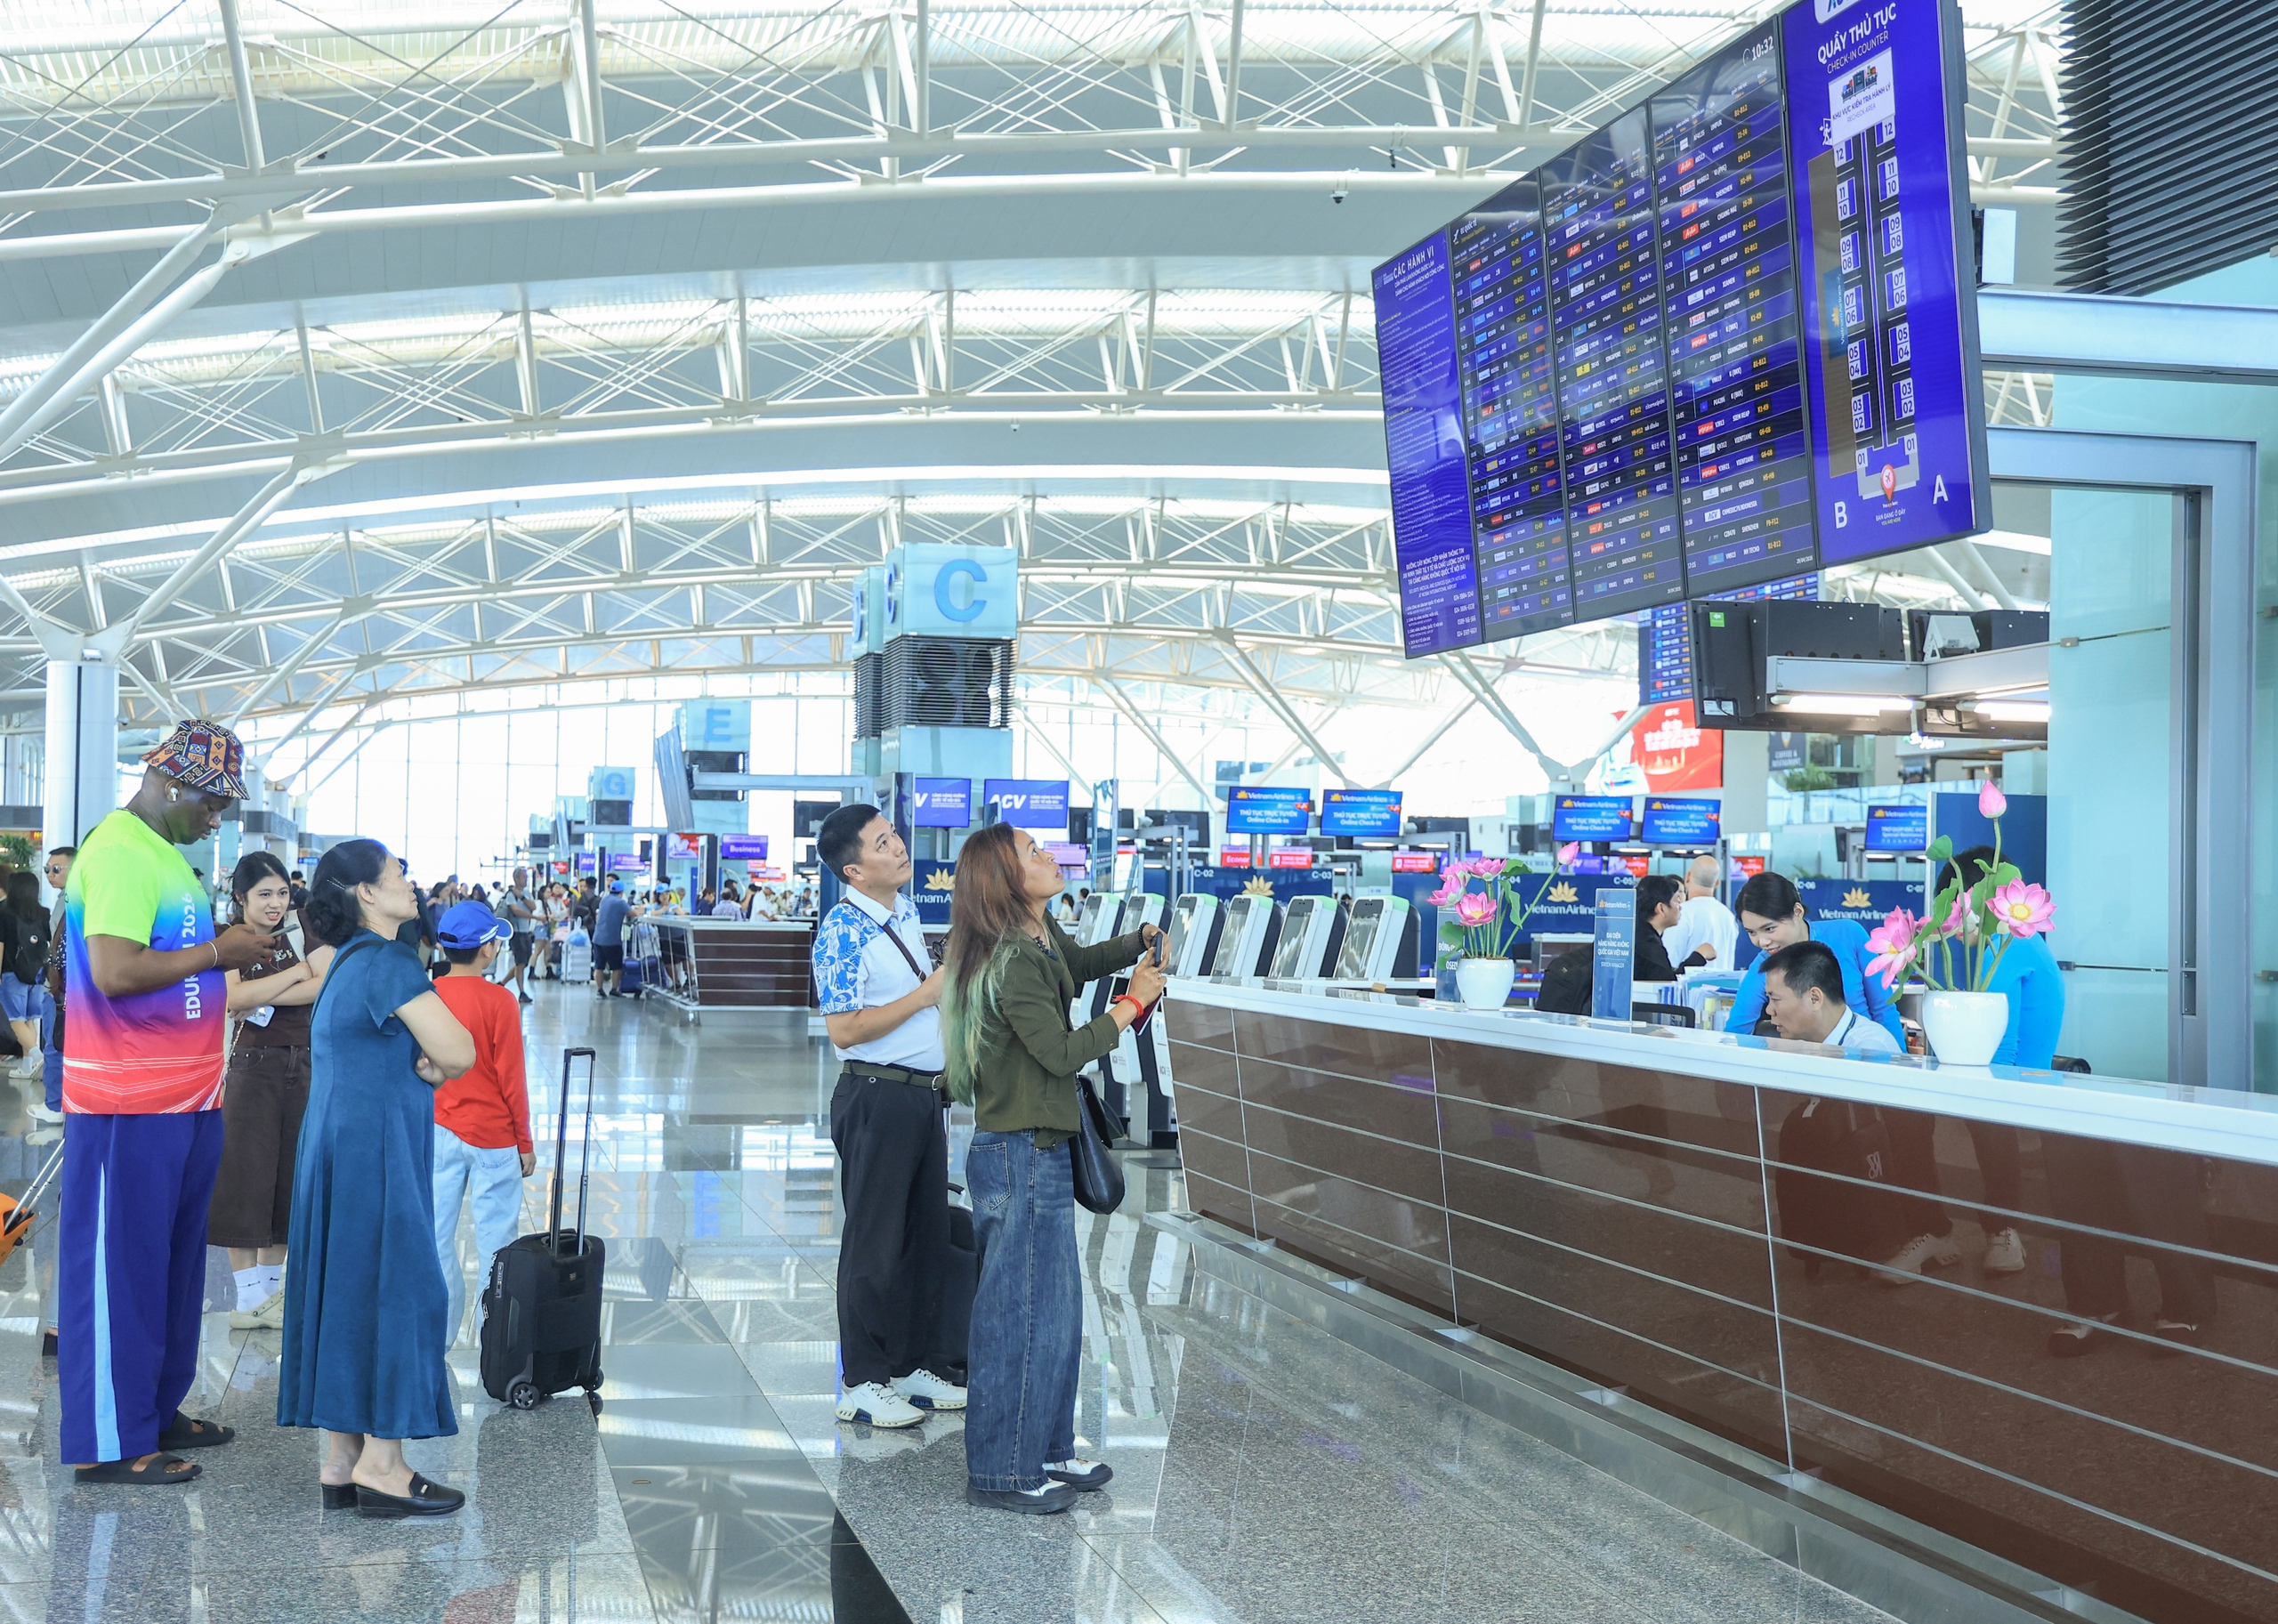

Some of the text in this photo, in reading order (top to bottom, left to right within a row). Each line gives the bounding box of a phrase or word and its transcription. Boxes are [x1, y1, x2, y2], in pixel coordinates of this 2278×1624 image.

[1818, 30, 1847, 64] QUẦY
[1849, 13, 1871, 44] THỦ
[1873, 3, 1897, 29] TỤC
[1752, 36, 1774, 61] 10:32
[1827, 30, 1888, 74] CHECK-IN COUNTER
[1832, 109, 1841, 121] KHU
[1841, 104, 1851, 117] VỰC
[1862, 94, 1871, 105] TRA
[1872, 88, 1886, 100] HÀNH
[1886, 83, 1891, 93] LÝ
[1846, 103, 1876, 123] RECHECK AREA
[1885, 122, 1893, 134] 12
[1836, 148, 1844, 160] 12
[1888, 162, 1895, 175] 11
[1839, 187, 1846, 199] 11
[1888, 180, 1896, 194] 10
[1839, 206, 1847, 220] 10
[1890, 216, 1900, 230] 09
[1842, 238, 1851, 253] 09
[1891, 234, 1902, 249] 08
[1393, 262, 1406, 279] CÁC
[1407, 250, 1426, 271] HÀNH
[1426, 246, 1434, 258] VI
[1843, 256, 1853, 271] 08
[1894, 271, 1903, 287] 07
[1845, 292, 1854, 306] 07
[1894, 289, 1905, 303] 06
[1846, 310, 1856, 323] 06
[1897, 327, 1908, 341] 05
[1848, 346, 1859, 360] 05
[1899, 345, 1910, 360] 04
[1850, 363, 1861, 377] 04
[1902, 382, 1912, 396] 03
[1853, 399, 1862, 412] 03
[1902, 400, 1913, 414] 02
[1854, 416, 1864, 430] 02
[1907, 438, 1915, 451] 01
[1857, 452, 1866, 465] 01
[1933, 474, 1949, 505] A
[1834, 501, 1848, 529] B
[934, 559, 988, 622] C
[705, 708, 732, 742] E
[602, 772, 626, 796] G
[537, 818, 551, 830] K
[730, 845, 761, 853] Business
[1226, 855, 1250, 863] Econo
[1194, 869, 1214, 877] C-02
[1313, 871, 1332, 879] C-03
[1613, 877, 1633, 885] C-05
[182, 893, 196, 938] 2026
[1566, 905, 1596, 915] Airline
[1818, 909, 1860, 919] Vietnam
